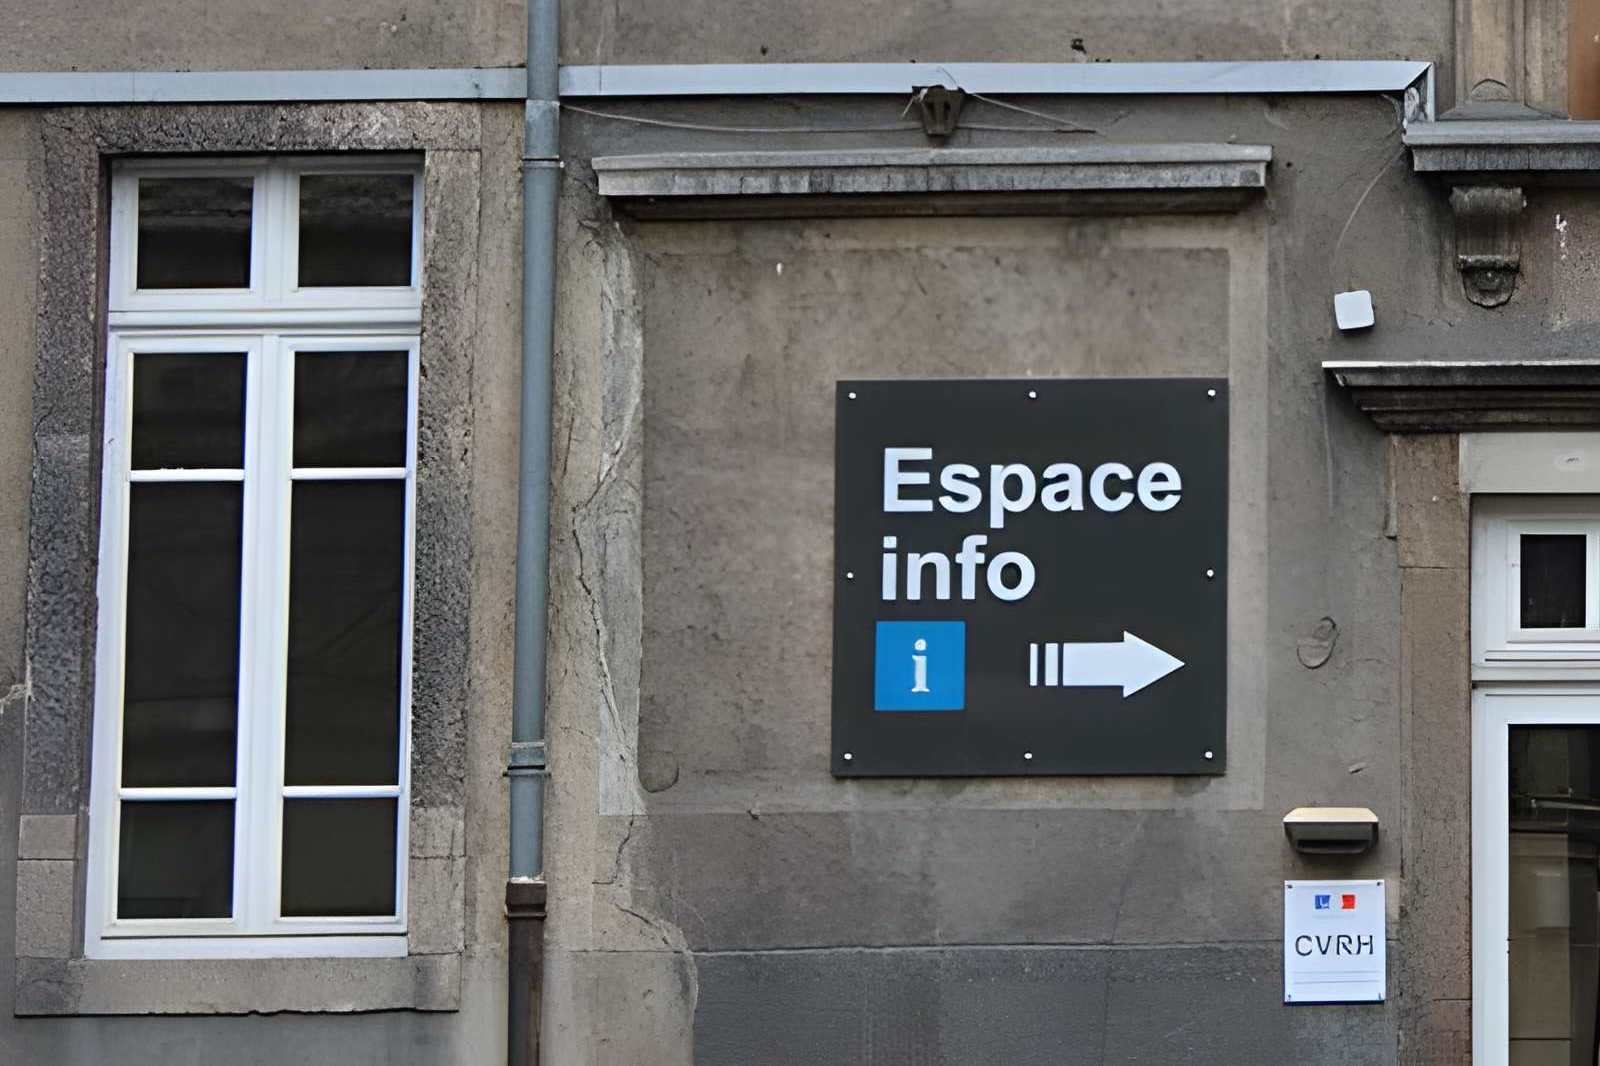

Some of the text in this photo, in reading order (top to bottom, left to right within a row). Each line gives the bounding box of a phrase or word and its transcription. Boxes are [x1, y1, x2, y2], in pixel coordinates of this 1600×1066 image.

[883, 447, 1182, 529] Espace
[882, 535, 1036, 601] info
[1295, 934, 1374, 957] CVRH
